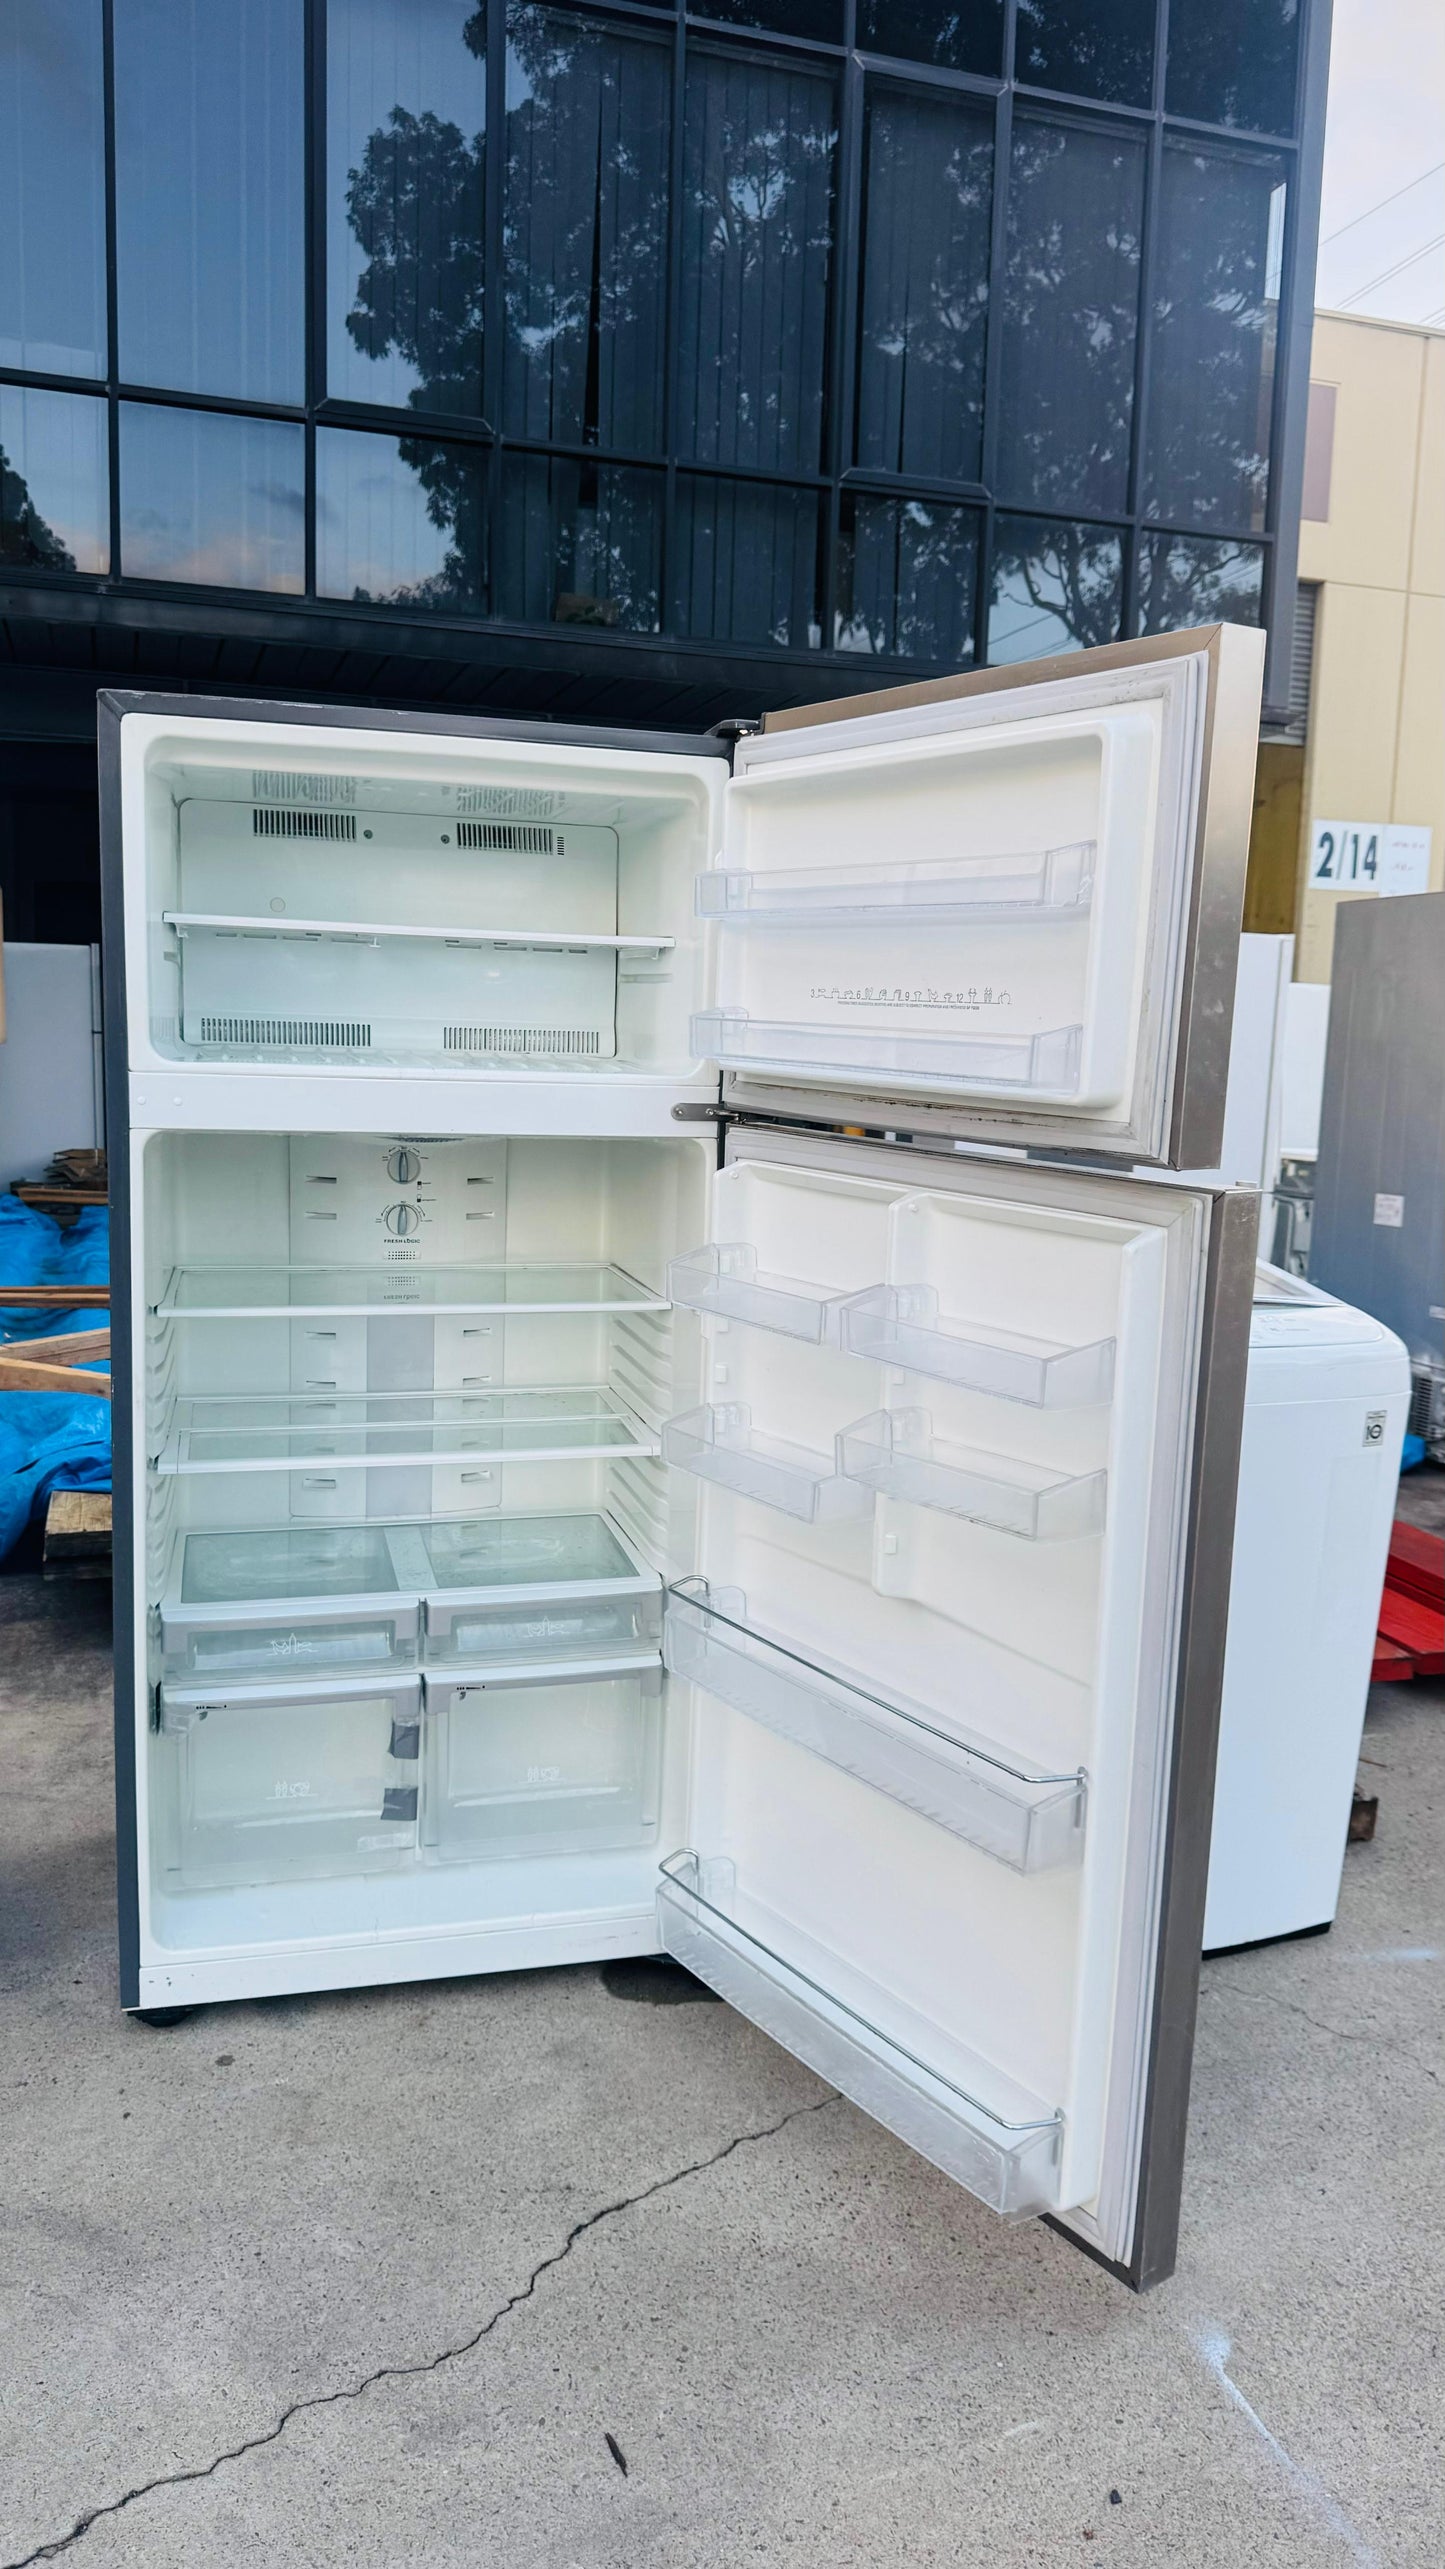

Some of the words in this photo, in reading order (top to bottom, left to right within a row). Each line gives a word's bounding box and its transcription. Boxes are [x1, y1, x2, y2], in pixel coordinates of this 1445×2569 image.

[1316, 830, 1377, 880] 2/14
[857, 990, 861, 1000] 6
[905, 991, 910, 1001] 9
[956, 993, 963, 1003] 12
